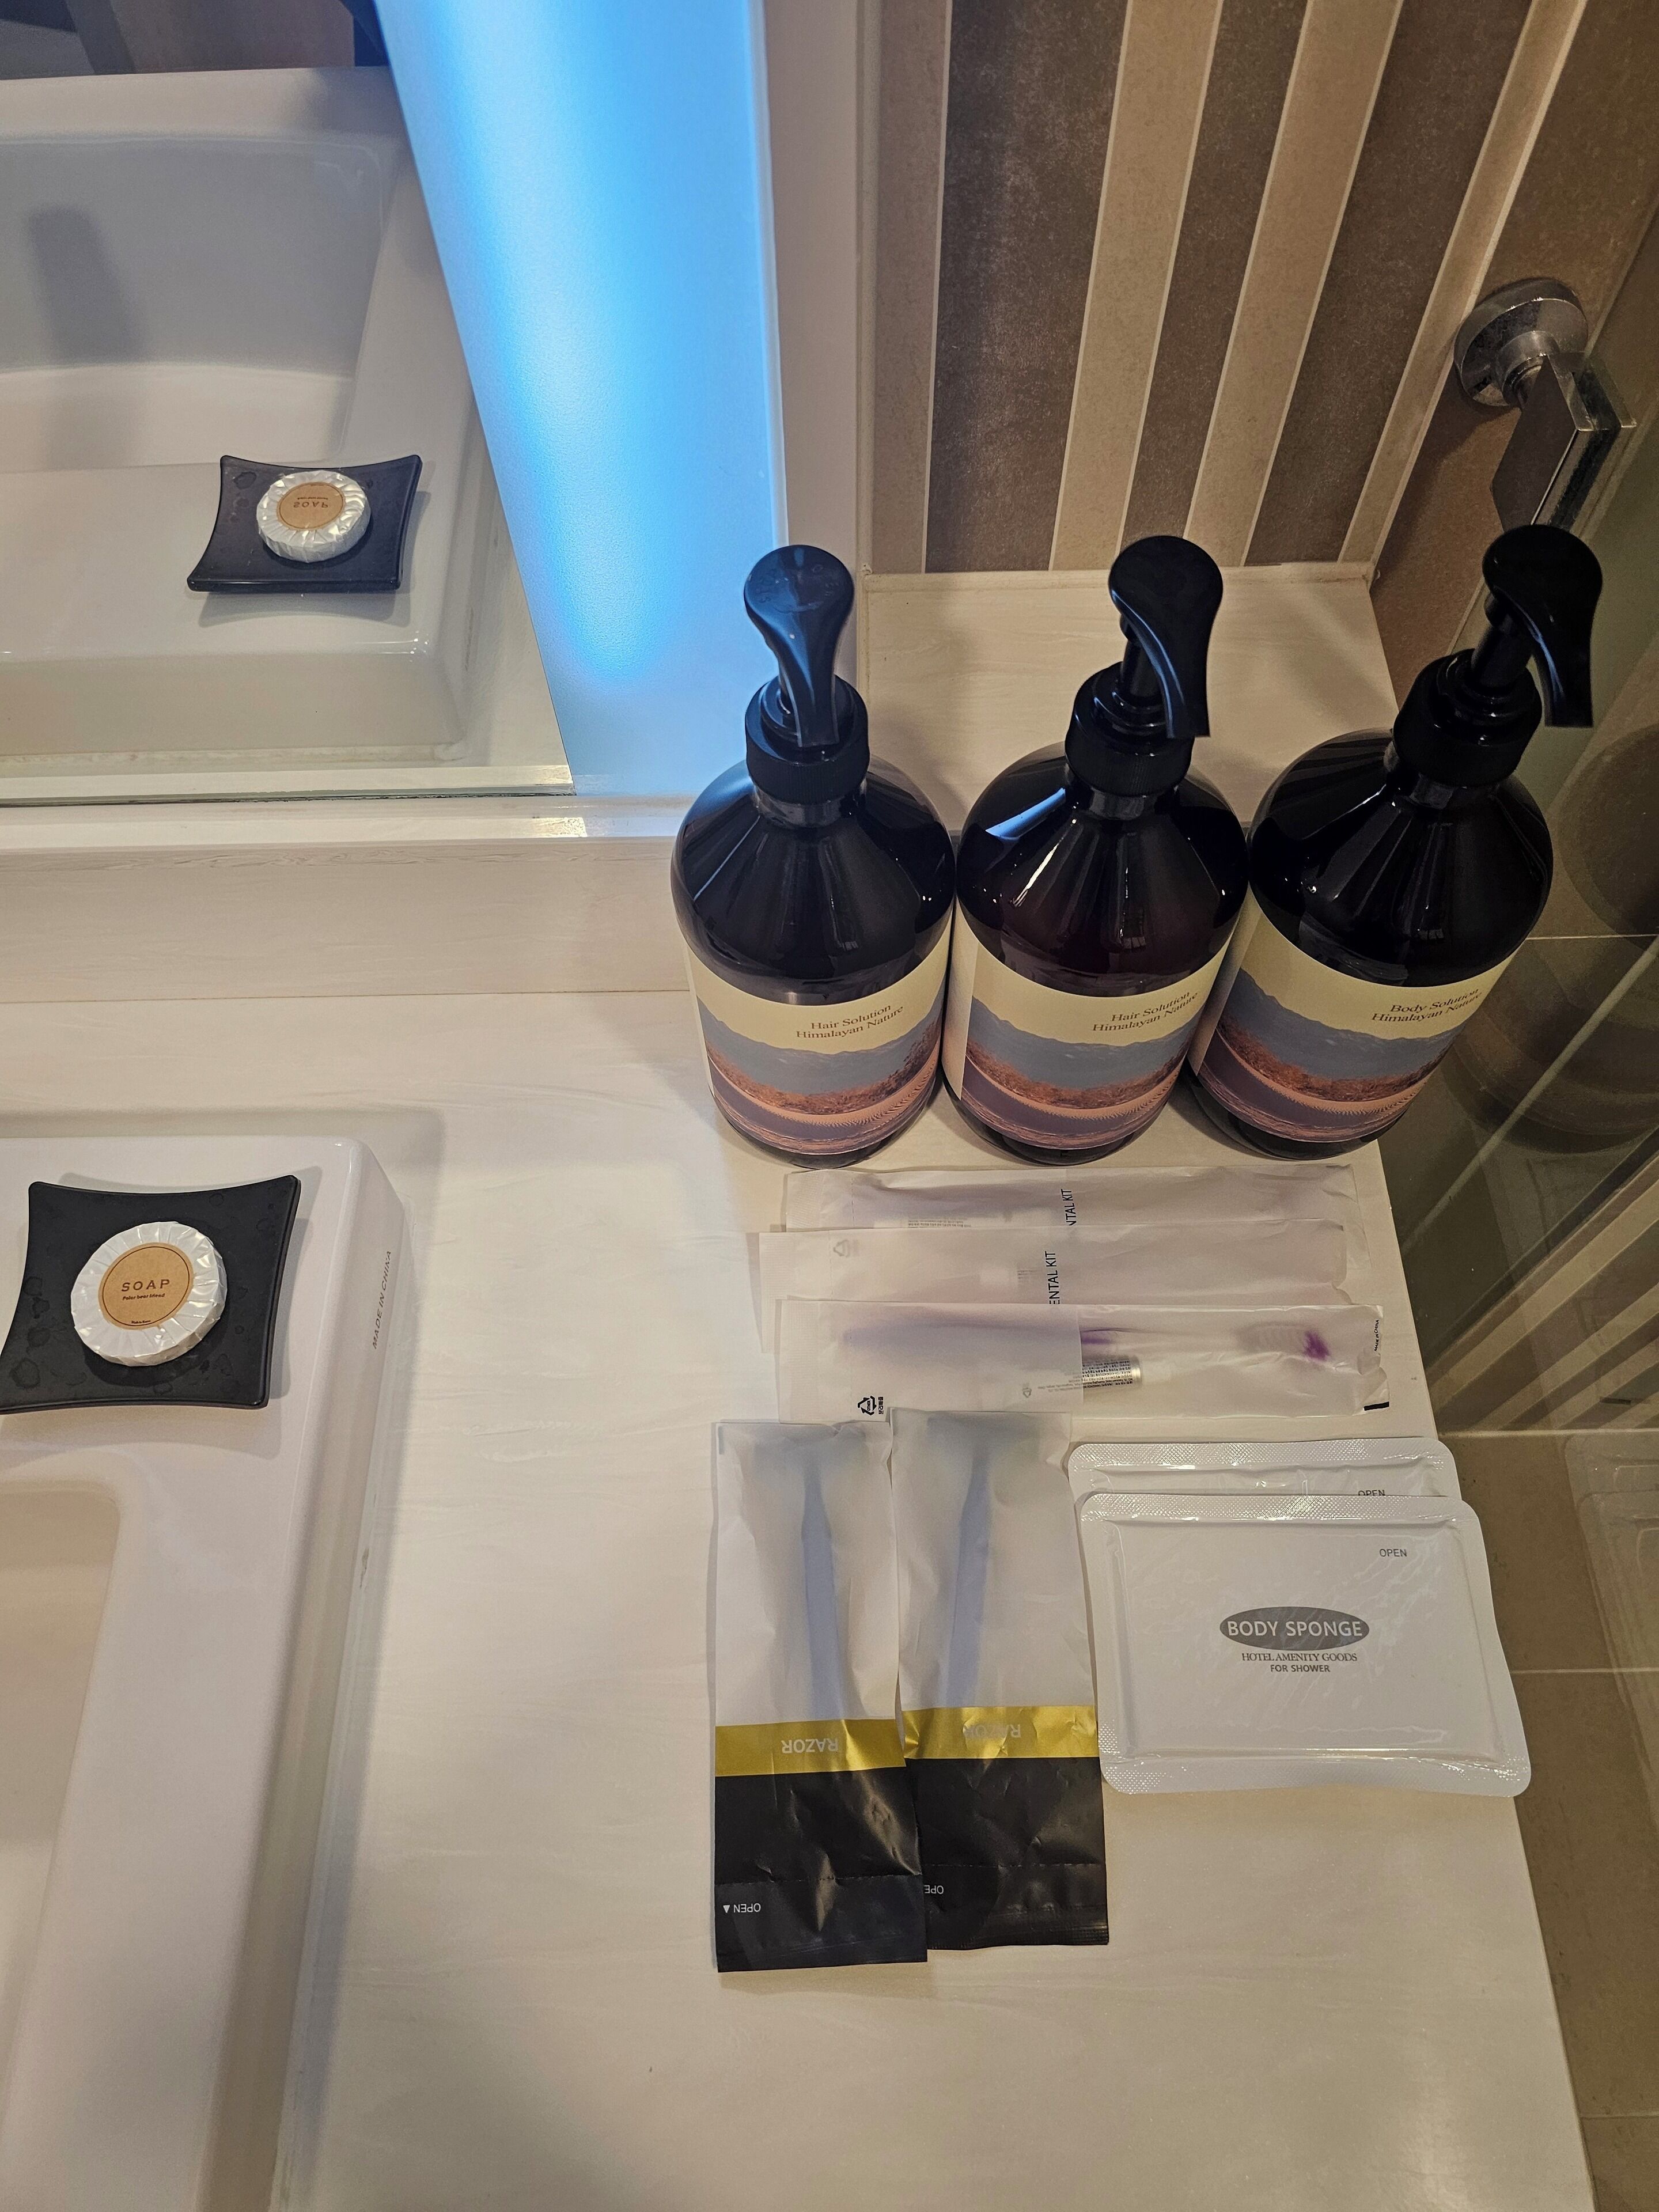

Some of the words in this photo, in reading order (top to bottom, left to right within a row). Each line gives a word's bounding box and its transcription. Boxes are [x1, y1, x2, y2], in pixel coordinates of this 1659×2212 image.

[1111, 1012, 1140, 1021] Hair
[1143, 992, 1190, 1017] Solution
[1372, 1011, 1442, 1022] Himalayan
[1445, 992, 1482, 1014] Nature
[1390, 1004, 1427, 1013] Body
[1429, 989, 1478, 1009] Solution
[811, 1021, 839, 1029] Hair
[842, 1005, 891, 1027] Solution
[1093, 1016, 1160, 1031] Himalayan
[1164, 993, 1198, 1018] Nature
[797, 1026, 863, 1038] Himalayan
[867, 1006, 903, 1028] Nature
[1061, 1189, 1073, 1201] KIT
[1065, 1203, 1077, 1226] NTAL
[1045, 1251, 1056, 1267] KIT
[121, 1279, 170, 1291] SOAP
[1047, 1270, 1060, 1304] ENTAL
[373, 1309, 382, 1349] MADE
[378, 1292, 384, 1308] IN
[382, 1251, 391, 1291] CHINA
[1379, 1548, 1407, 1557] OPEN
[1227, 1621, 1278, 1636] BODY
[1285, 1621, 1363, 1637] SPONGE
[1242, 1653, 1274, 1661] HOTEL
[1275, 1653, 1319, 1661] AMENITY
[1322, 1653, 1358, 1661] GOODS
[1271, 1664, 1288, 1672] FOR
[1291, 1664, 1330, 1672] SHOWER
[781, 1738, 839, 1753] RAZOR
[924, 1885, 944, 1895] OPE
[733, 1903, 761, 1912] OPEN
